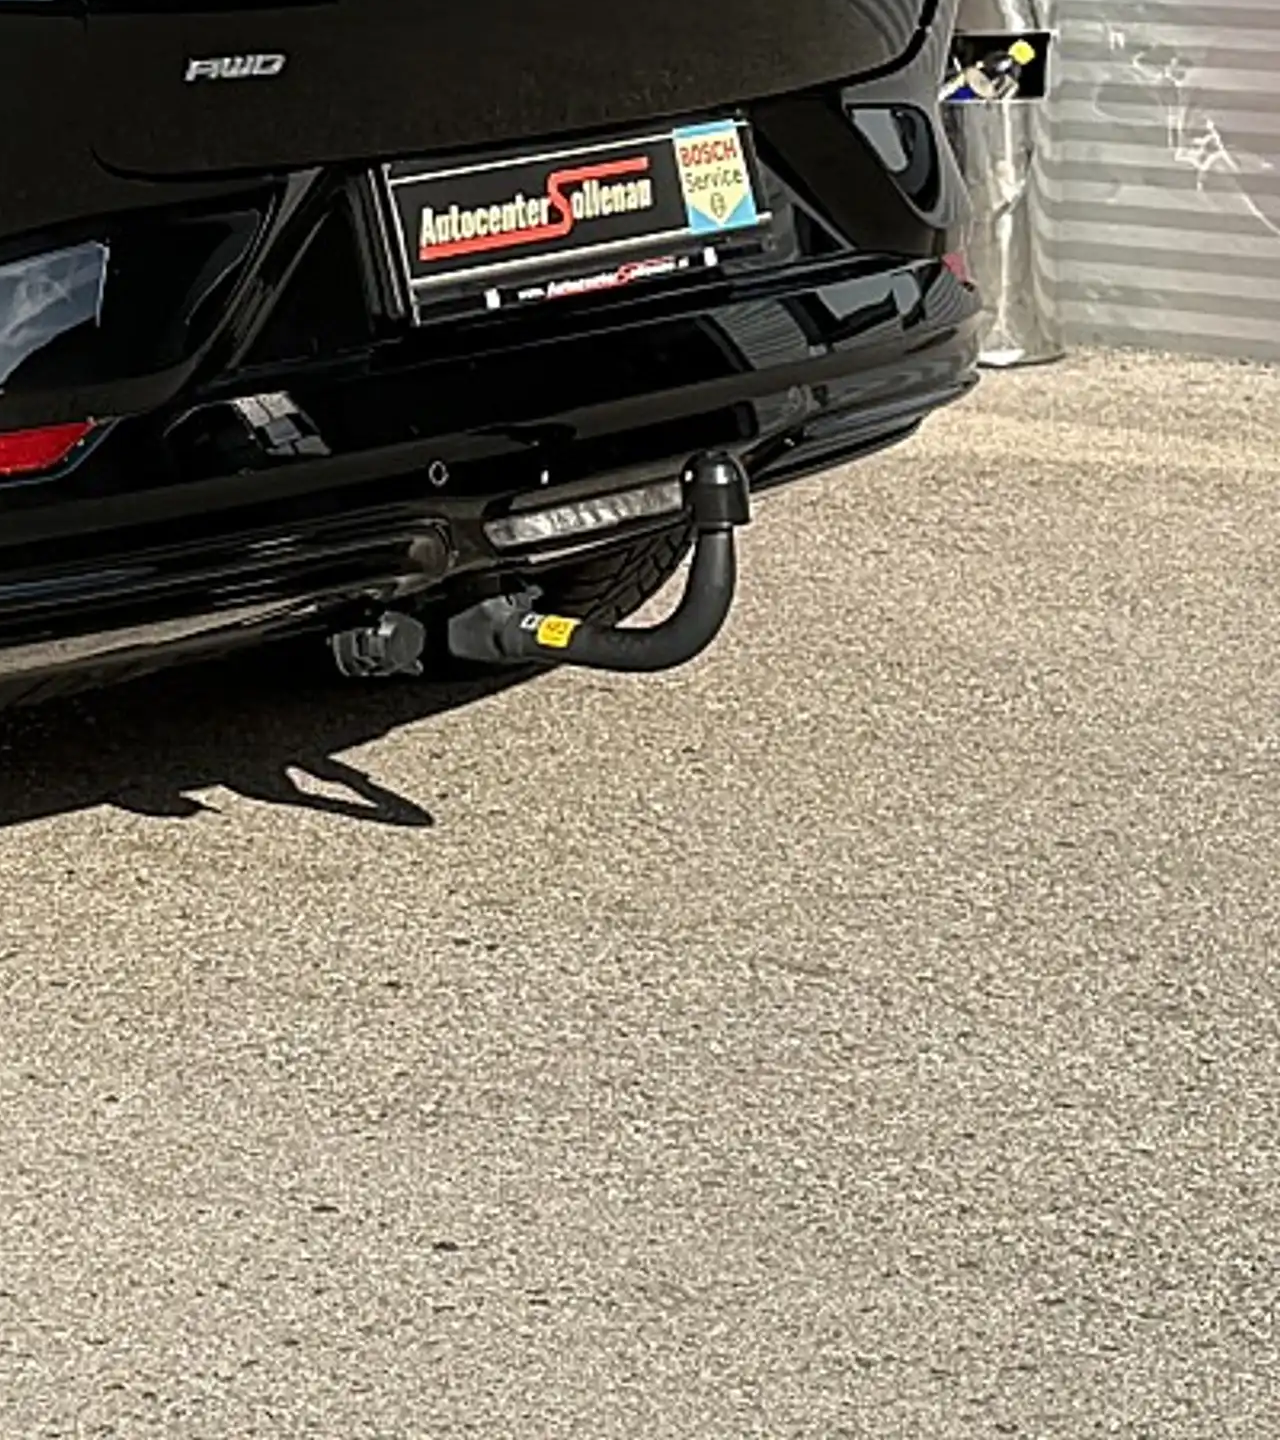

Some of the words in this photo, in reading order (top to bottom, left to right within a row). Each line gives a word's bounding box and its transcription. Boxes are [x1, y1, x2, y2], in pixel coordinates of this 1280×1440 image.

[184, 54, 286, 81] AWD
[680, 138, 737, 167] BOSCH
[685, 166, 744, 193] Service
